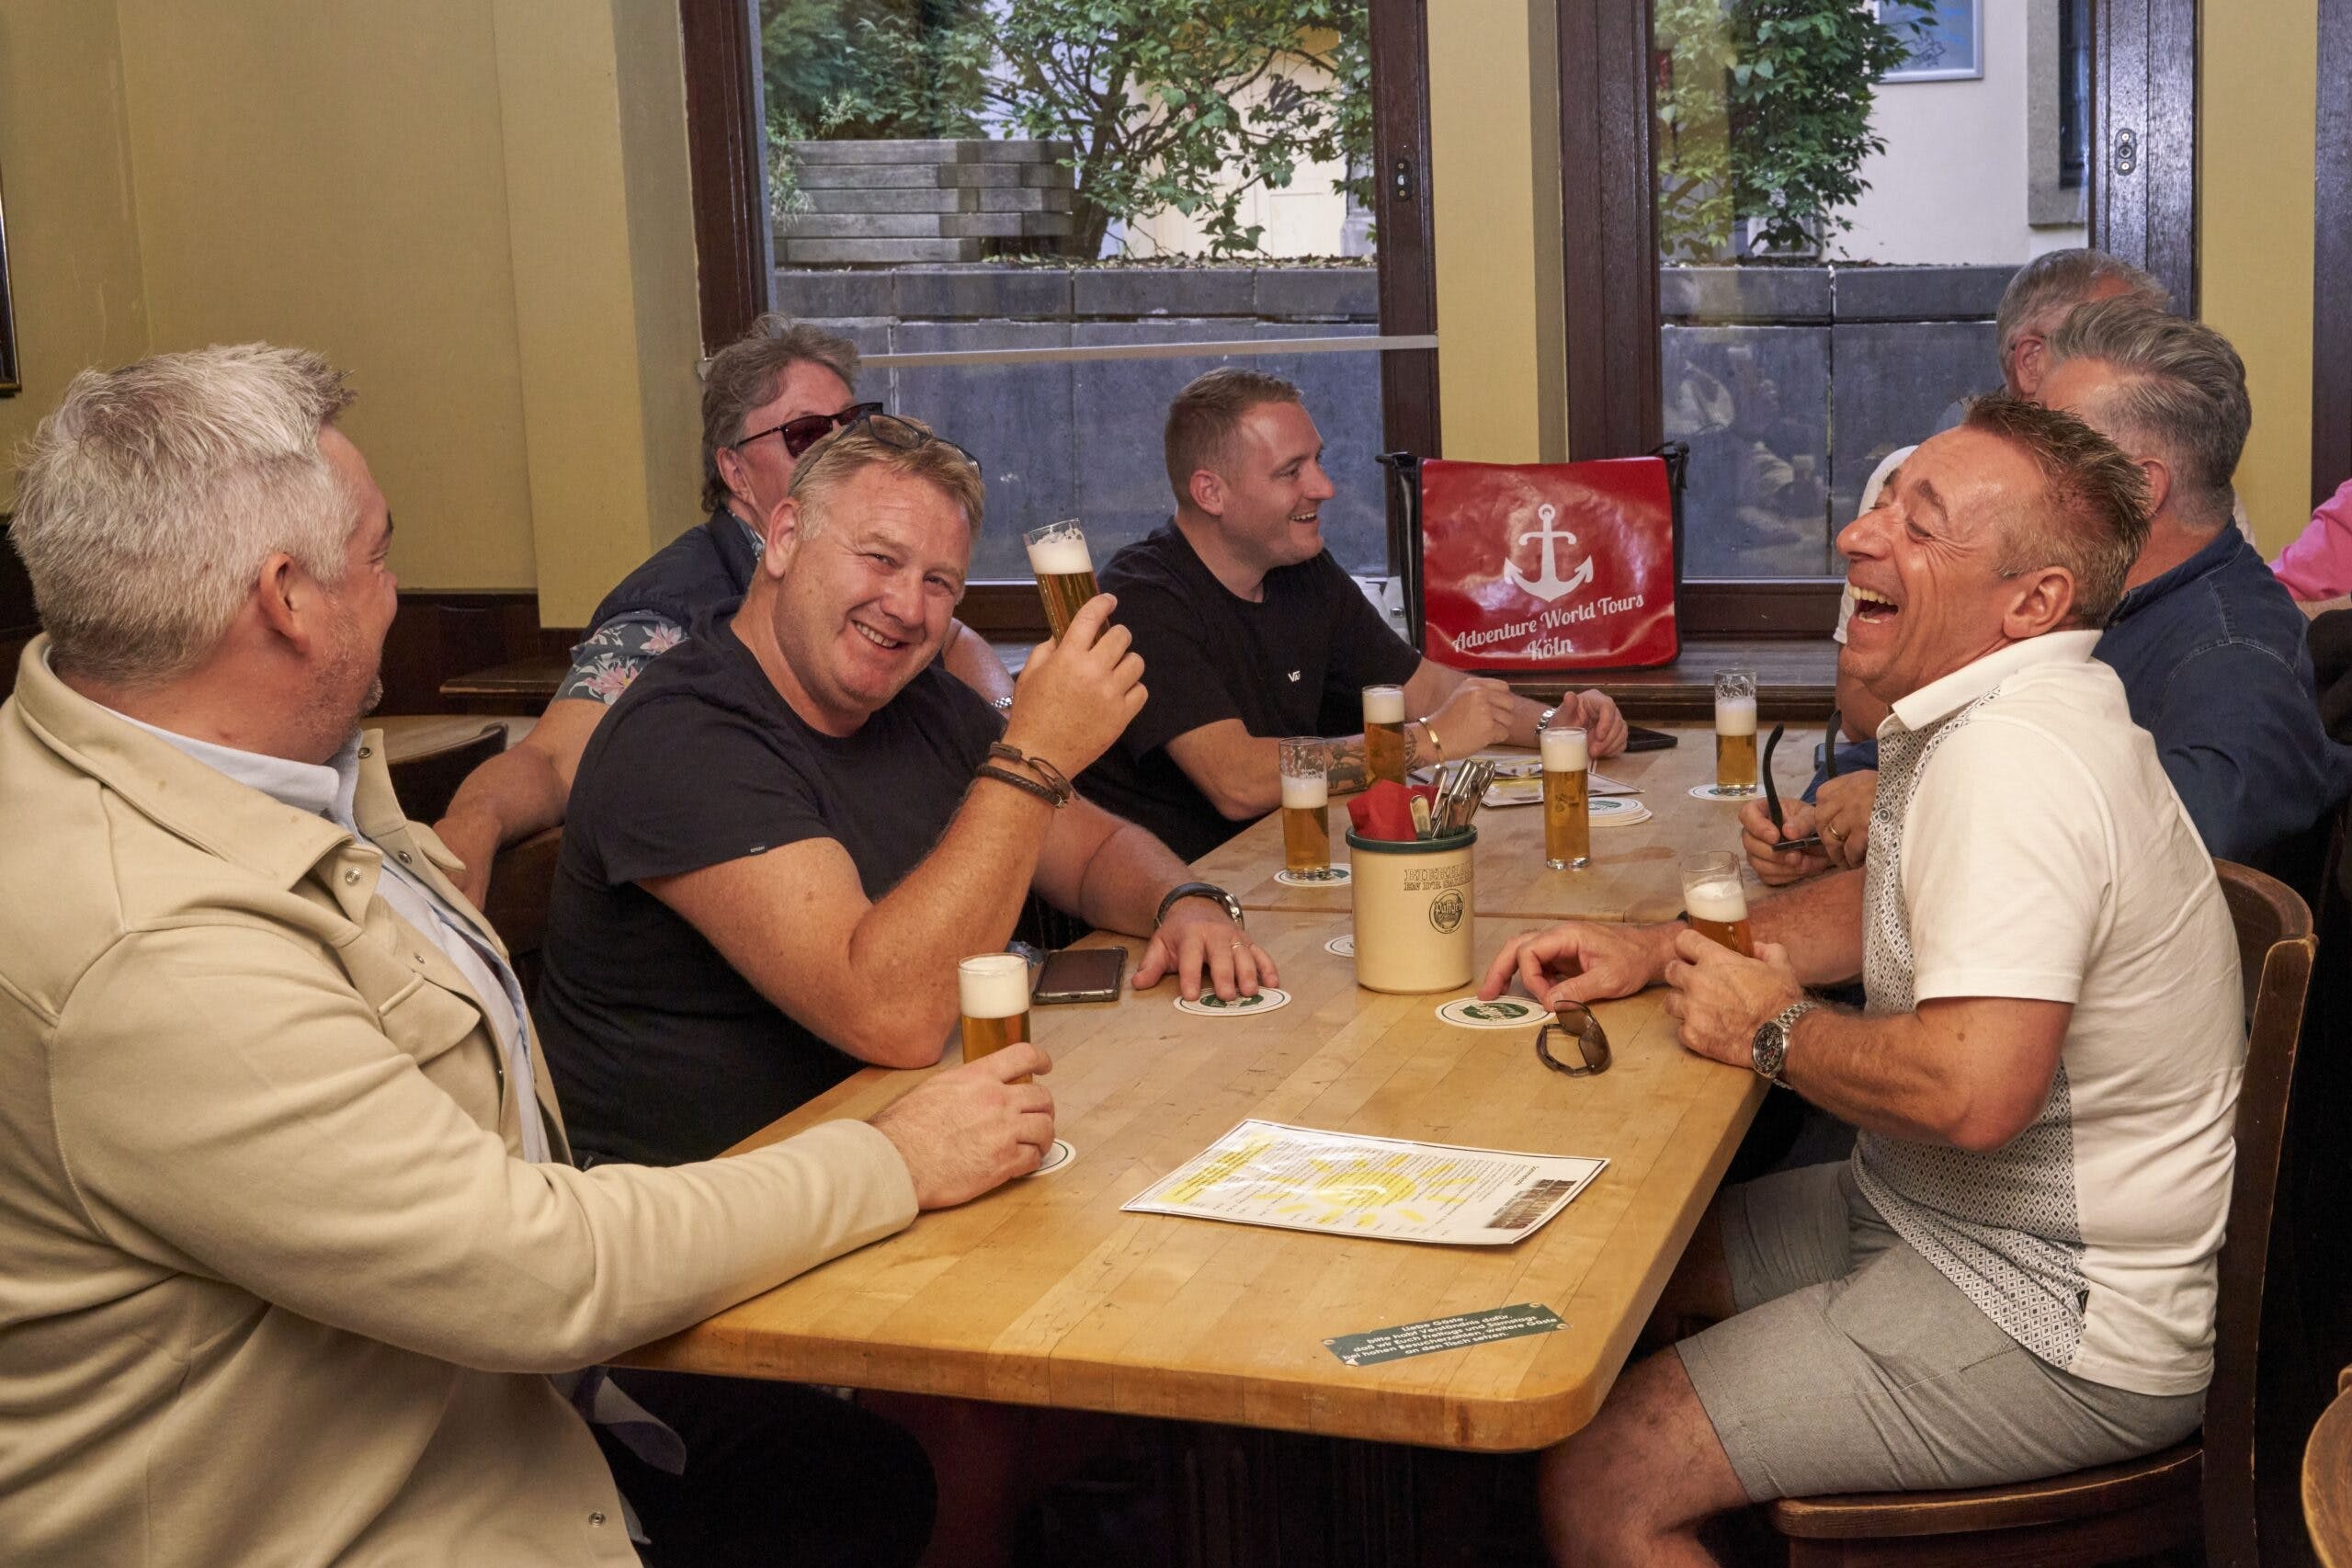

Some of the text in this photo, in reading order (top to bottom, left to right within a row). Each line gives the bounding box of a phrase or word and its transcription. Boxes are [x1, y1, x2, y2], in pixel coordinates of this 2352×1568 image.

[1451, 594, 1645, 653] Adventure World Tours
[1526, 636, 1574, 661] Köln
[1353, 1344, 1375, 1352] daß
[1393, 1335, 1421, 1345] Euch
[1465, 1324, 1485, 1332] und
[1488, 1315, 1538, 1327] Samstags
[1362, 1346, 1397, 1357] hohen
[1485, 1324, 1525, 1334] weitere
[1527, 1318, 1558, 1326] Gäste
[1367, 1335, 1392, 1344] bitte
[1392, 1330, 1418, 1339] habt
[1420, 1319, 1480, 1334] Verständnis
[1402, 1323, 1430, 1332] Liebe
[1422, 1343, 1443, 1351] den
[1444, 1338, 1471, 1346] Tisch
